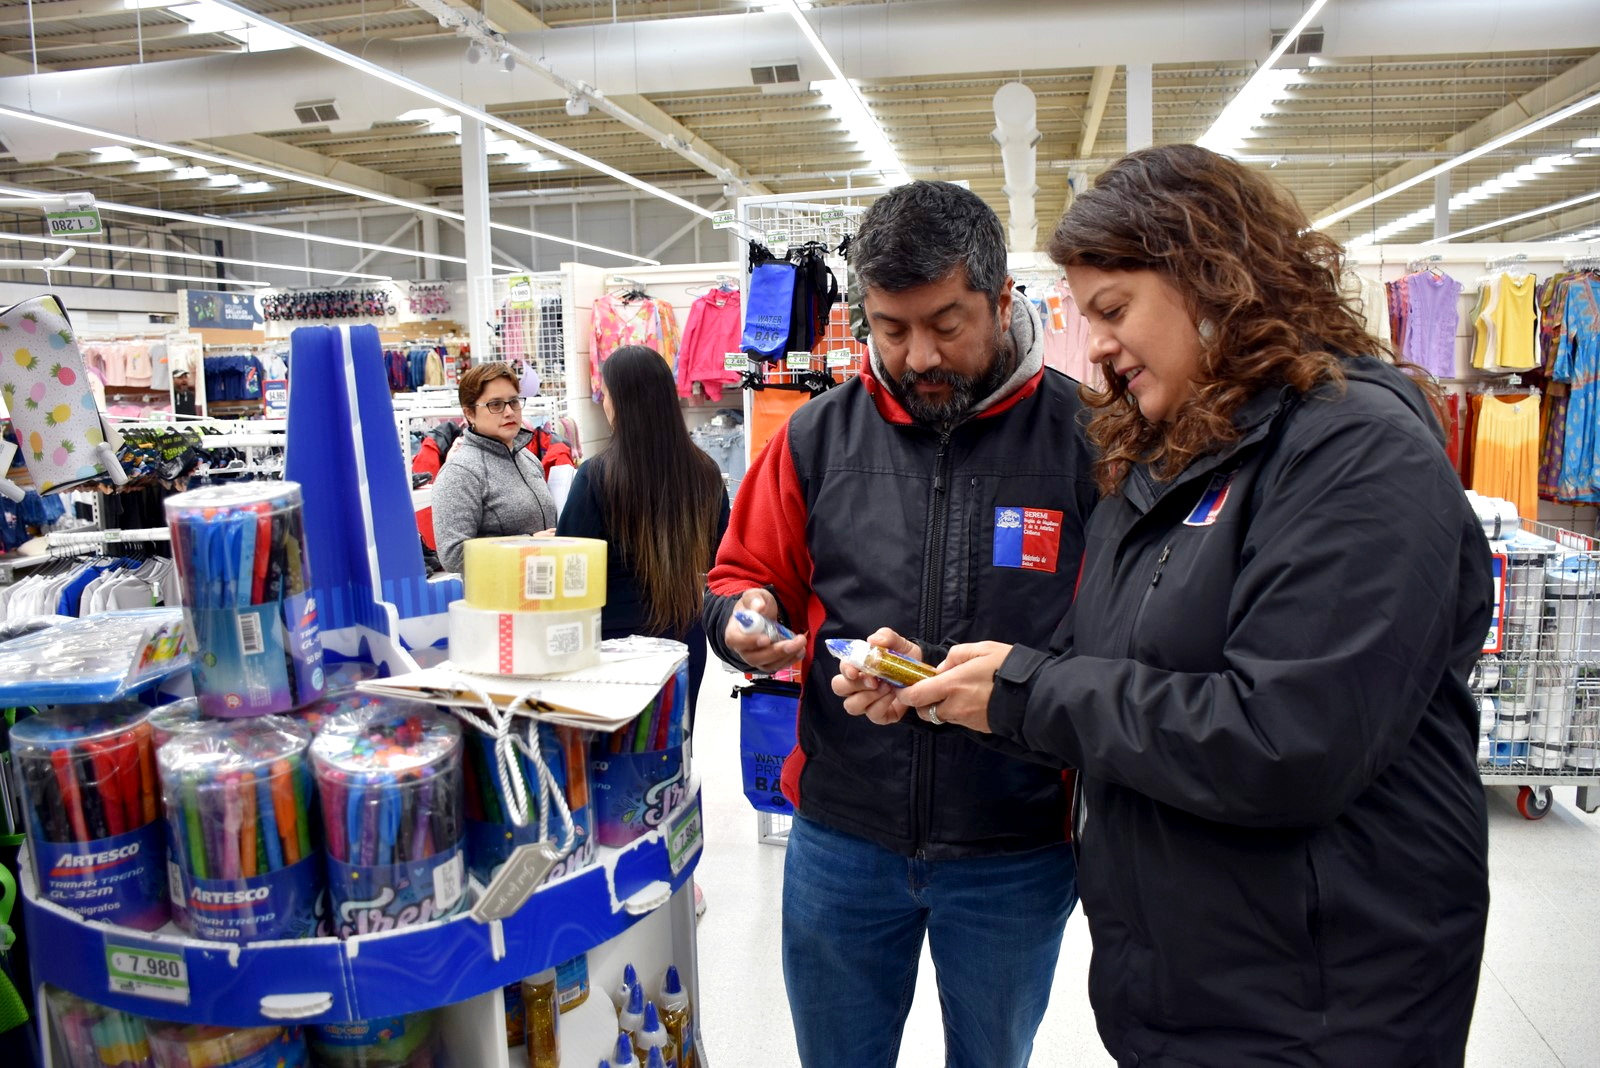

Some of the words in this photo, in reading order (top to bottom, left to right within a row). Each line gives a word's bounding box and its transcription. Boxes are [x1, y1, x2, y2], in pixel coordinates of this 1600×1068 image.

[52, 219, 84, 231] 1.280
[757, 315, 783, 323] WATER
[754, 331, 780, 341] BAG
[1024, 511, 1048, 519] SEREMI
[756, 764, 781, 777] PRO
[756, 777, 782, 793] BA
[56, 842, 139, 868] ARTESCO
[49, 886, 113, 899] GL-32M
[191, 887, 269, 904] ARTESCO
[129, 954, 180, 978] 7.980
